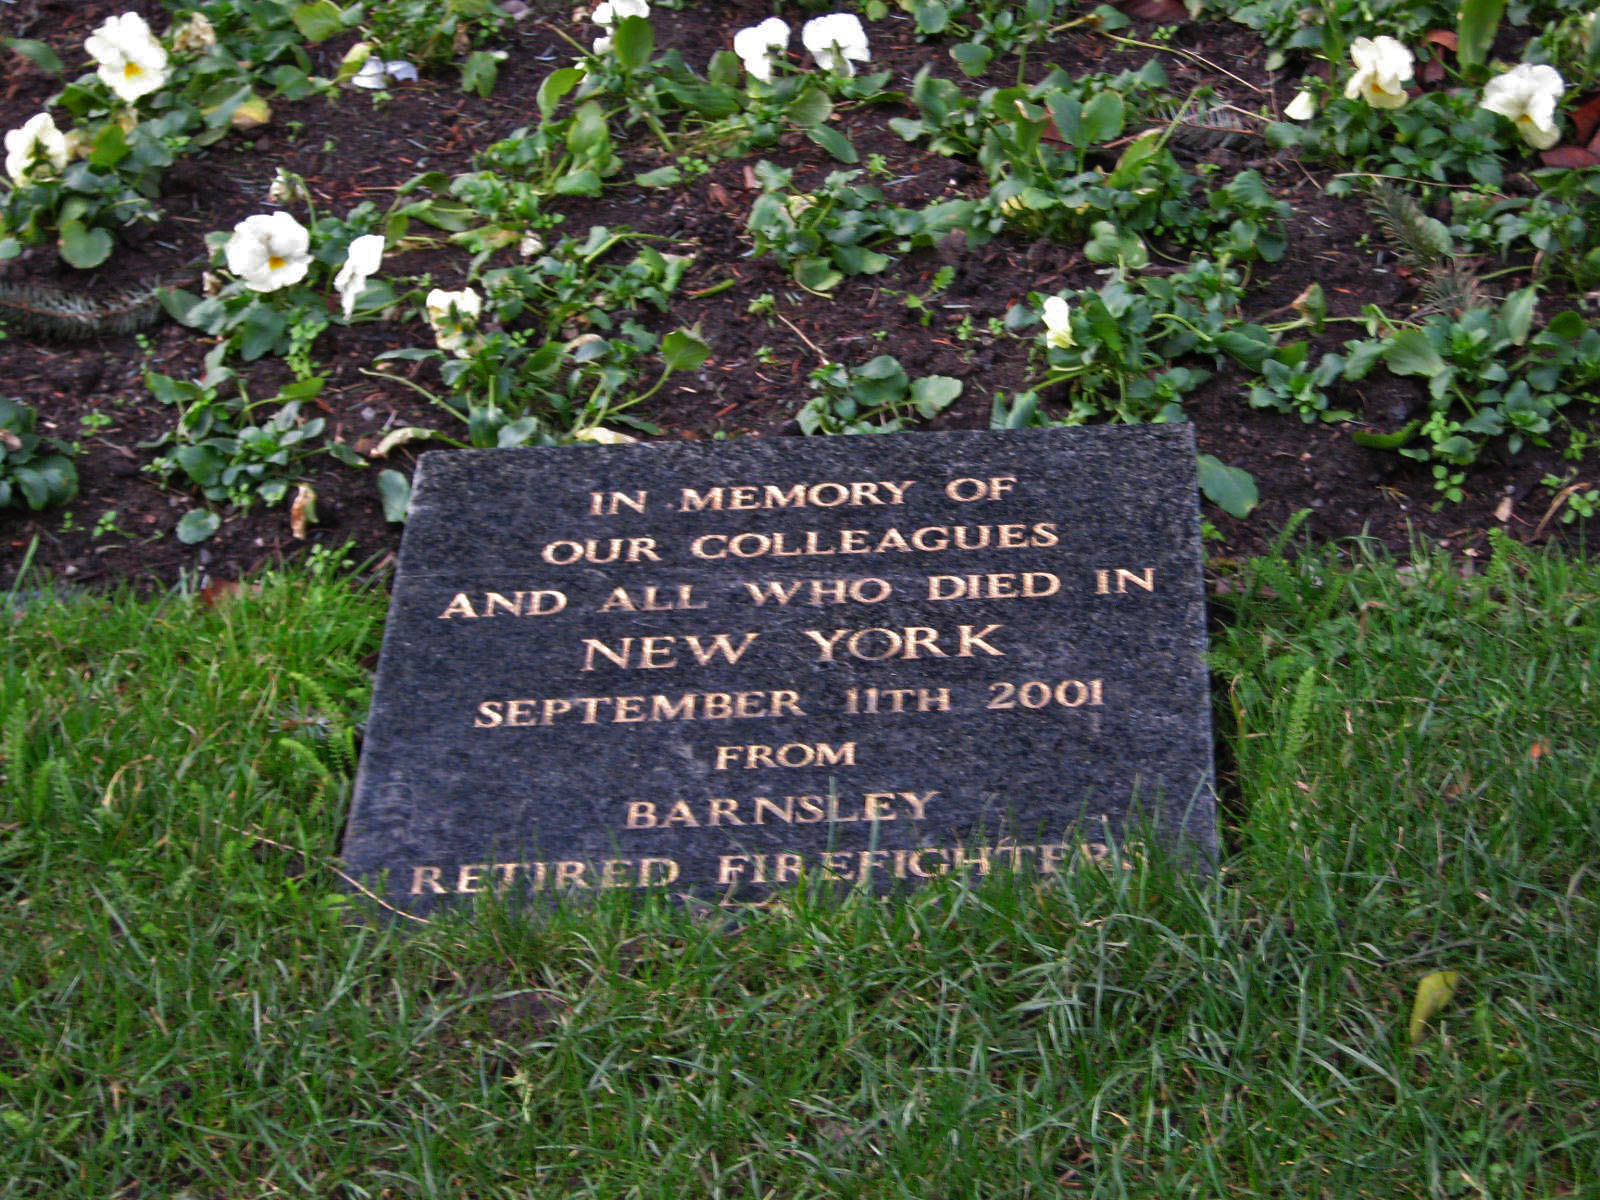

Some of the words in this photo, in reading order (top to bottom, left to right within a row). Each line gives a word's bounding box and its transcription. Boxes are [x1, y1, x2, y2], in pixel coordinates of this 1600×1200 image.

[590, 490, 649, 516] IN
[678, 480, 917, 513] MEMORY
[945, 476, 1018, 502] OF
[541, 537, 662, 566] OUR
[689, 522, 1060, 561] COLLEAGUES
[437, 589, 569, 620] AND
[595, 584, 709, 613] ALL
[743, 577, 894, 607] WHO
[927, 571, 1062, 602] DIED
[1094, 567, 1157, 596] IN
[579, 632, 761, 673] NEW
[804, 623, 1007, 664] YORK
[473, 689, 807, 728] SEPTEMBER
[843, 686, 952, 715] 11TH
[985, 679, 1105, 711] 2001
[714, 741, 858, 771] FROM
[625, 790, 941, 829] BARNSLEY
[409, 856, 681, 896] RETIRED
